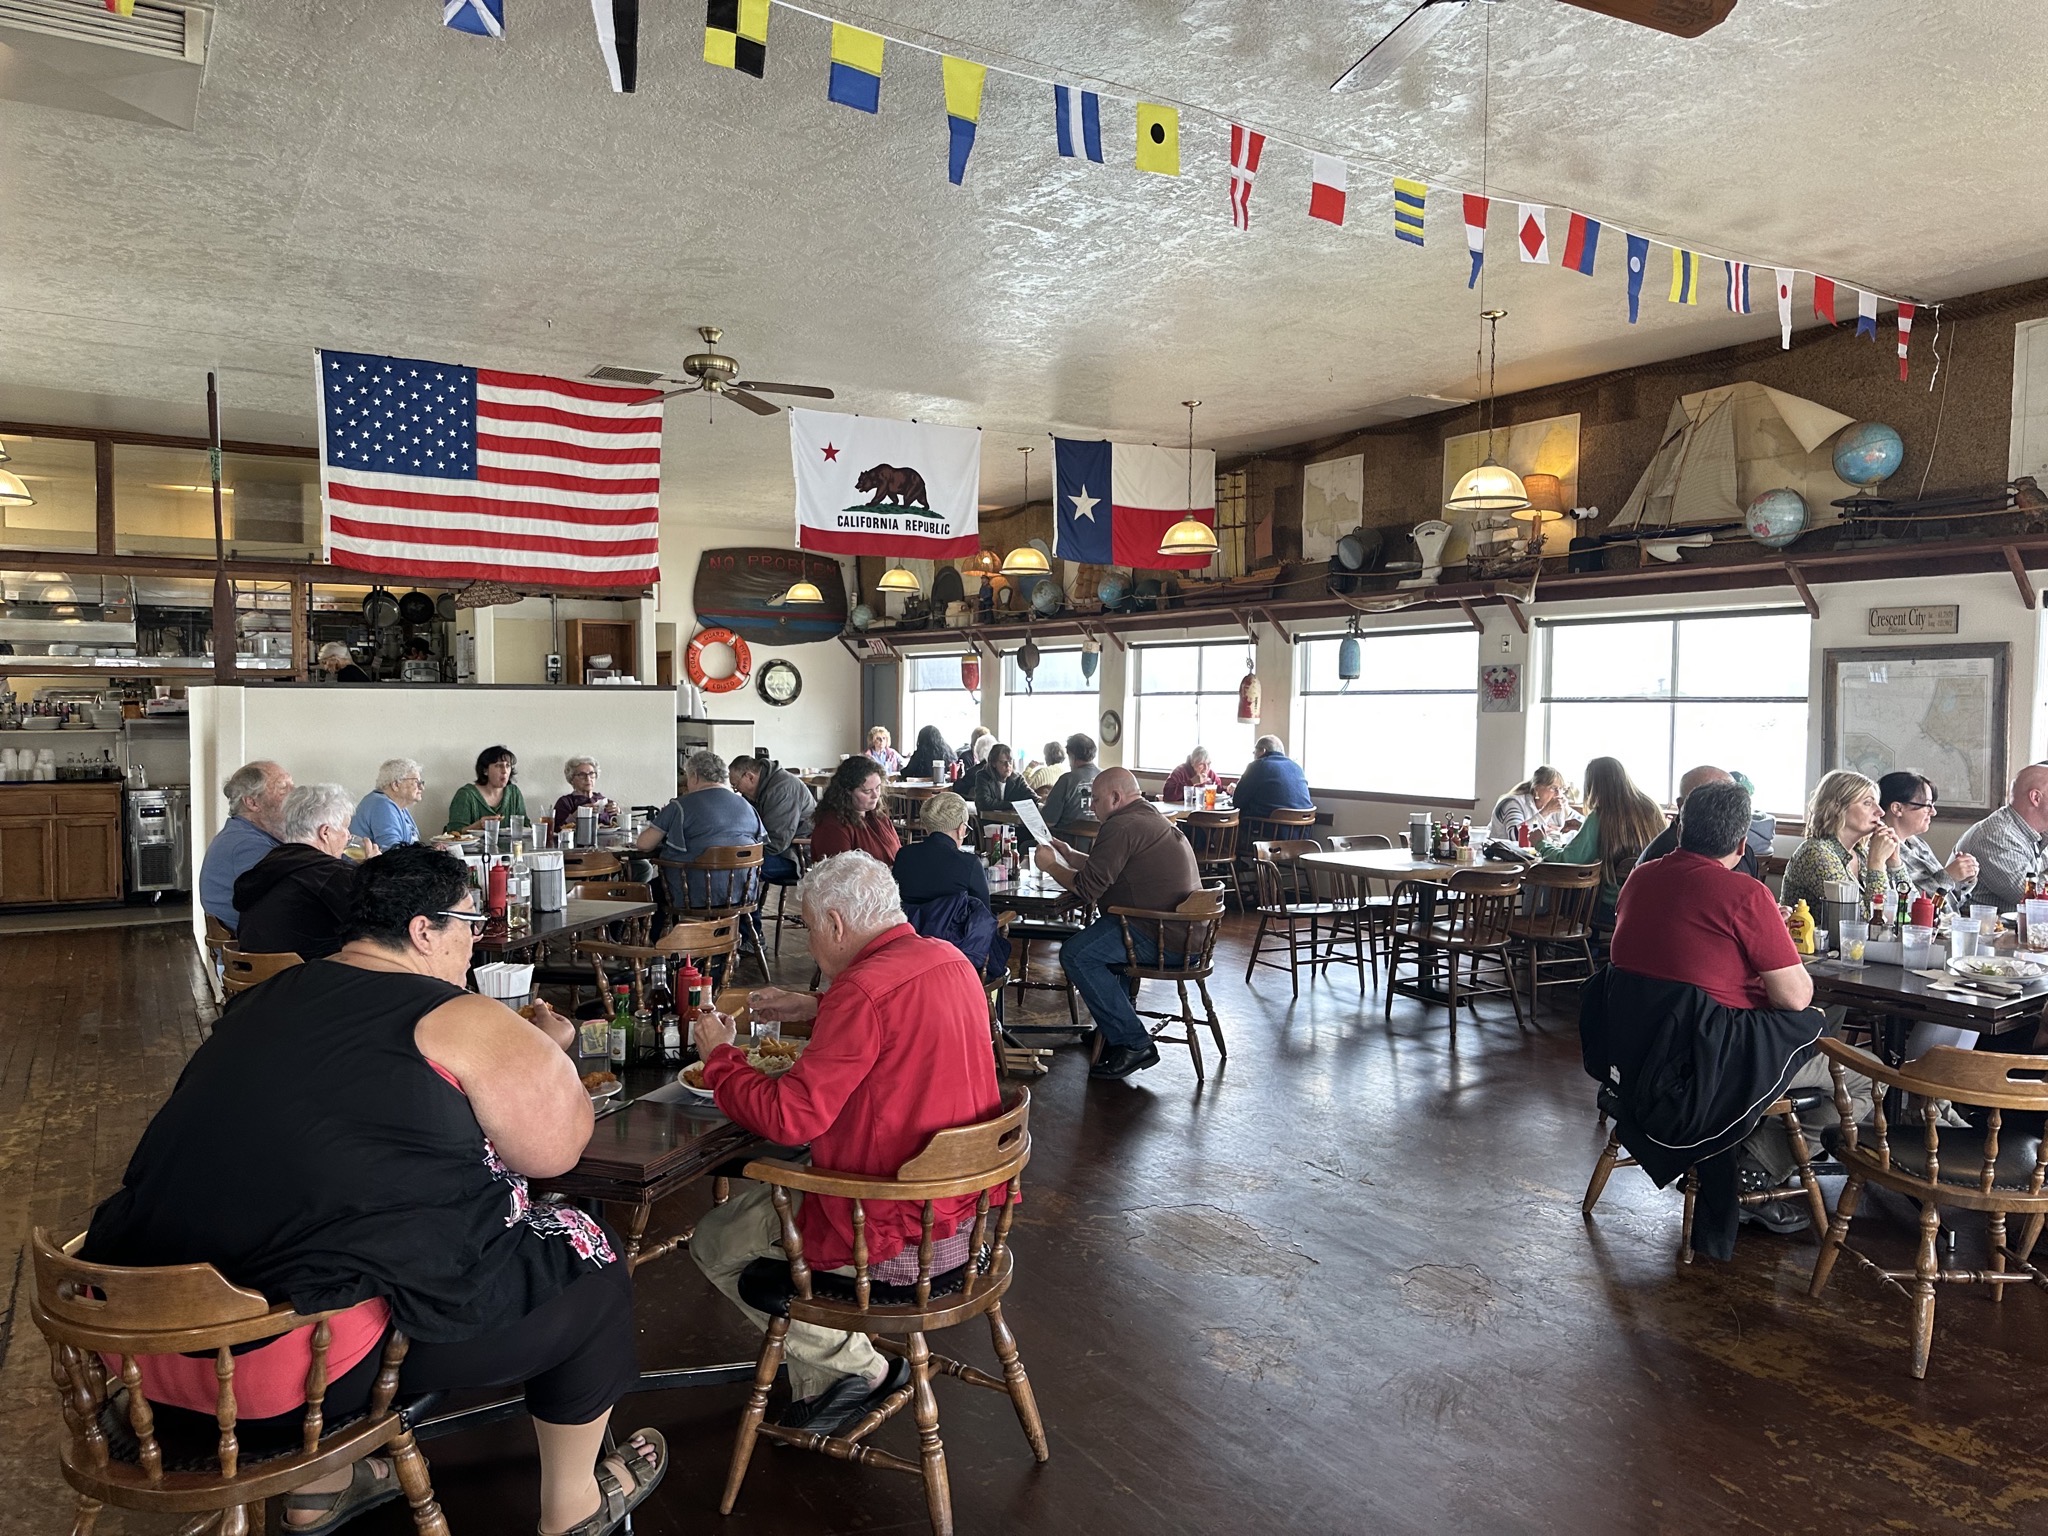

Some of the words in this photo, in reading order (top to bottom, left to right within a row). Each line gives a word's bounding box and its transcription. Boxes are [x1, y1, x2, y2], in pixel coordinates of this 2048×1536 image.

[837, 515, 899, 530] CALIFORNIA
[905, 519, 950, 535] REPUBLIC
[709, 556, 735, 570] NO
[1870, 609, 1906, 628] Crescent
[1908, 608, 1926, 631] City
[690, 648, 698, 669] COAST
[703, 631, 725, 641] GUARD
[868, 640, 886, 655] EXIT
[712, 681, 735, 690] EDISTO
